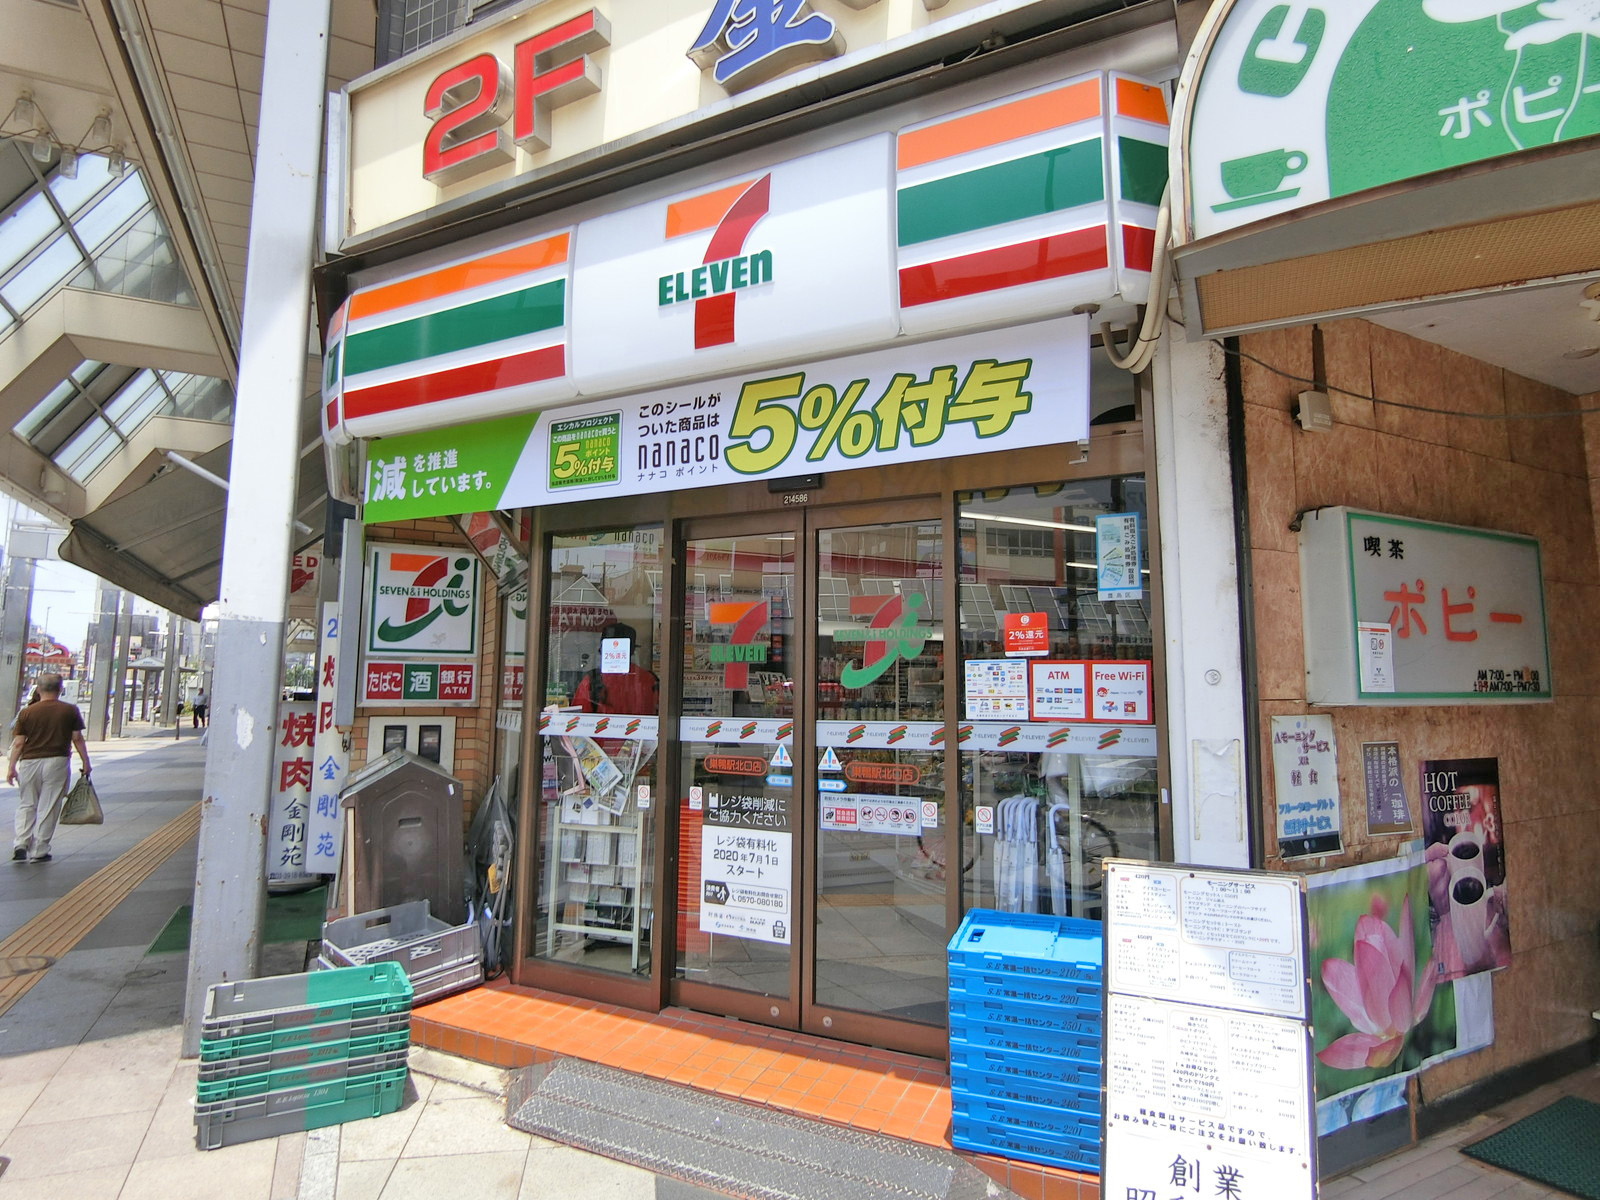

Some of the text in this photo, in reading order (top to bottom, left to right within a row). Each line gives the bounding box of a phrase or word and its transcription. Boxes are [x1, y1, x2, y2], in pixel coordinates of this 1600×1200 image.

[422, 8, 606, 184] 2F
[638, 393, 721, 418] このシールが
[557, 416, 613, 431] エシカルプロジェクト
[724, 358, 1032, 475] 5%付与
[638, 413, 720, 440] ついた商品は
[586, 437, 611, 449] nanaco
[413, 448, 458, 472] を推進
[553, 442, 614, 479] 5%付与
[586, 448, 611, 458] ポイント
[638, 434, 720, 471] nanaco
[364, 454, 407, 504] 減
[637, 464, 719, 482] ナナコ ポイント
[411, 470, 493, 498] しています。
[784, 494, 808, 505] 214586
[1363, 536, 1404, 560] 喫茶
[423, 587, 470, 600] HOLDINGS
[1384, 578, 1522, 642] ポピー
[878, 628, 933, 641] HOLDINGS
[1008, 629, 1044, 640] 2%還元
[368, 671, 402, 693] たばこ
[410, 671, 431, 693] 酒
[441, 670, 472, 685] 銀行
[1048, 671, 1070, 680] ATM
[1095, 671, 1145, 681] Free Wi-Fi
[444, 686, 468, 695] ATM
[279, 711, 316, 793] 焼肉
[1303, 740, 1330, 754] サービス
[709, 759, 762, 772] 巣鴨駅北口店
[852, 766, 913, 780] 巣鴨駅北口店
[1291, 768, 1318, 786] 軽食
[1387, 746, 1405, 825] 本格派の「珈琲」
[1424, 771, 1457, 794] HOT
[317, 756, 341, 858] 金剛苑
[720, 794, 786, 812] レジ袋削減に
[1279, 798, 1335, 815] フルーツヨーグルト
[1429, 793, 1471, 812] COFFEE
[709, 809, 787, 827] ご協力ください
[280, 797, 308, 867] 金剛苑
[717, 835, 777, 852] レジ袋有料化
[713, 849, 779, 866] 2020年7月1日
[726, 865, 764, 879] スタート
[1207, 880, 1256, 889] モーニングサービス
[737, 896, 783, 908] 0570-080180
[1168, 1153, 1245, 1200] 創業
